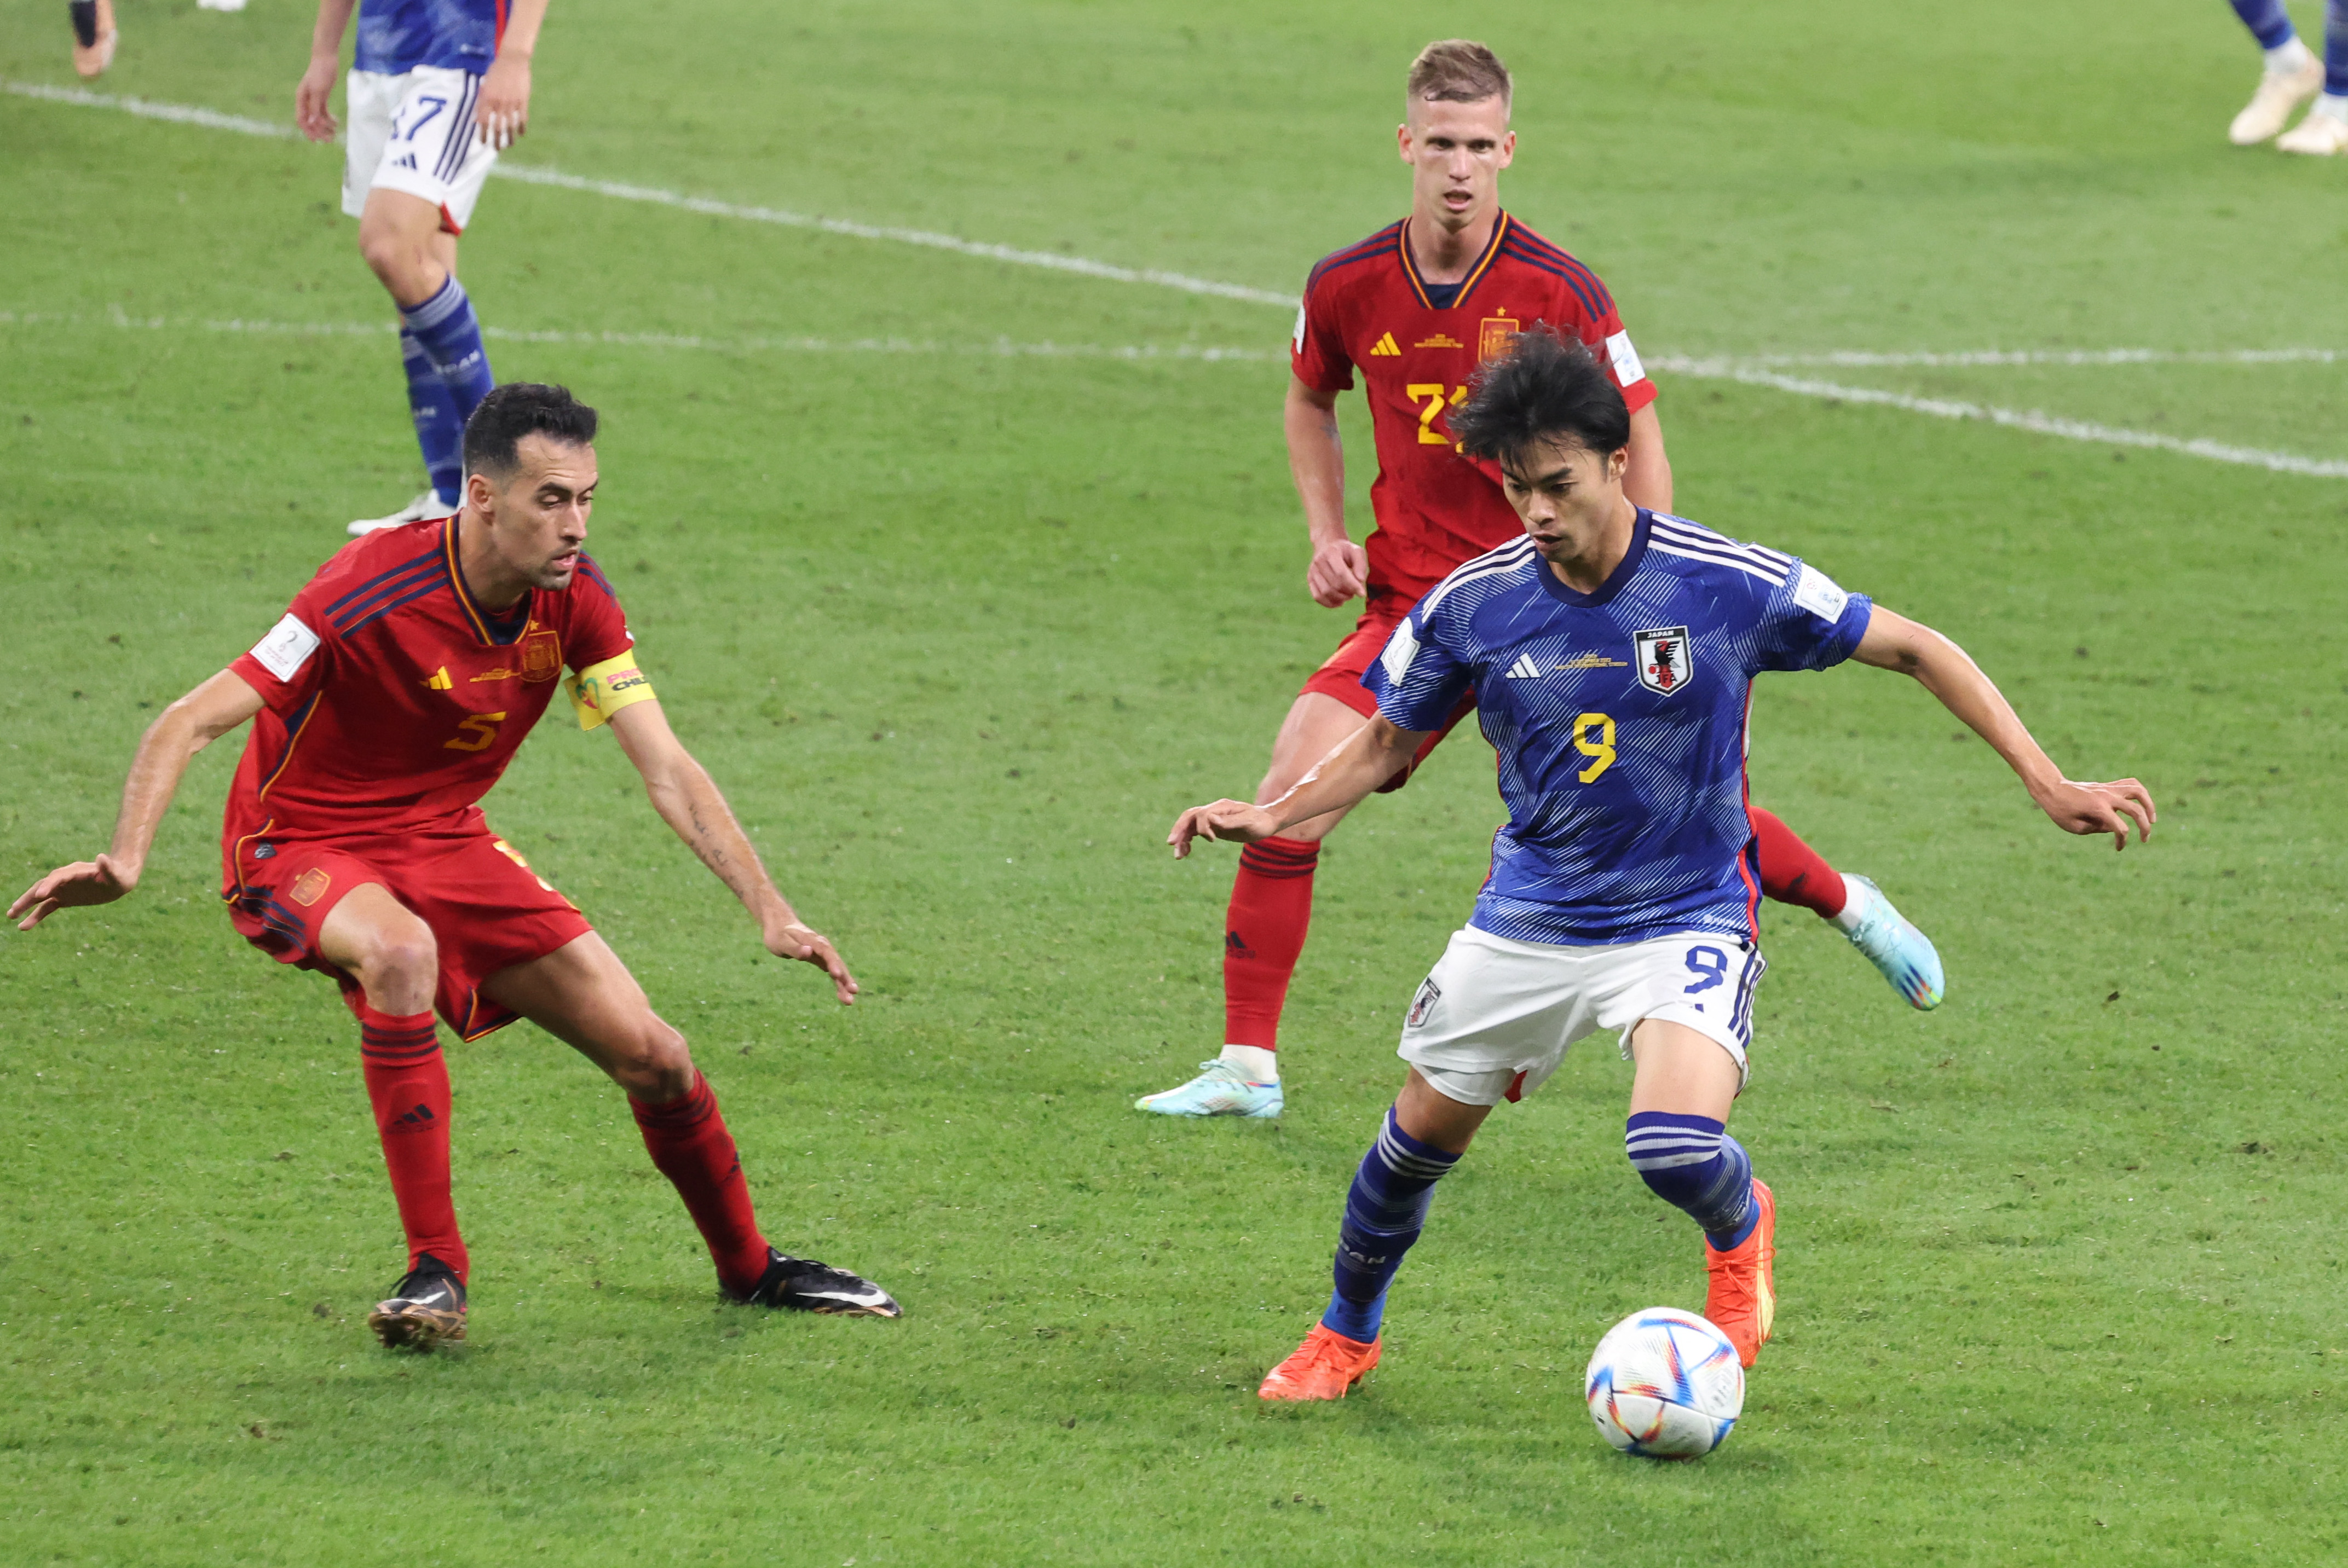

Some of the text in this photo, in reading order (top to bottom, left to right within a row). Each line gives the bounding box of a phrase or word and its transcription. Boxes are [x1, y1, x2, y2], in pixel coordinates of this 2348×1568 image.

[1647, 629, 1675, 639] JAPAN
[444, 711, 507, 751] 5
[1573, 713, 1617, 784] 9
[1684, 945, 1728, 994] 9
